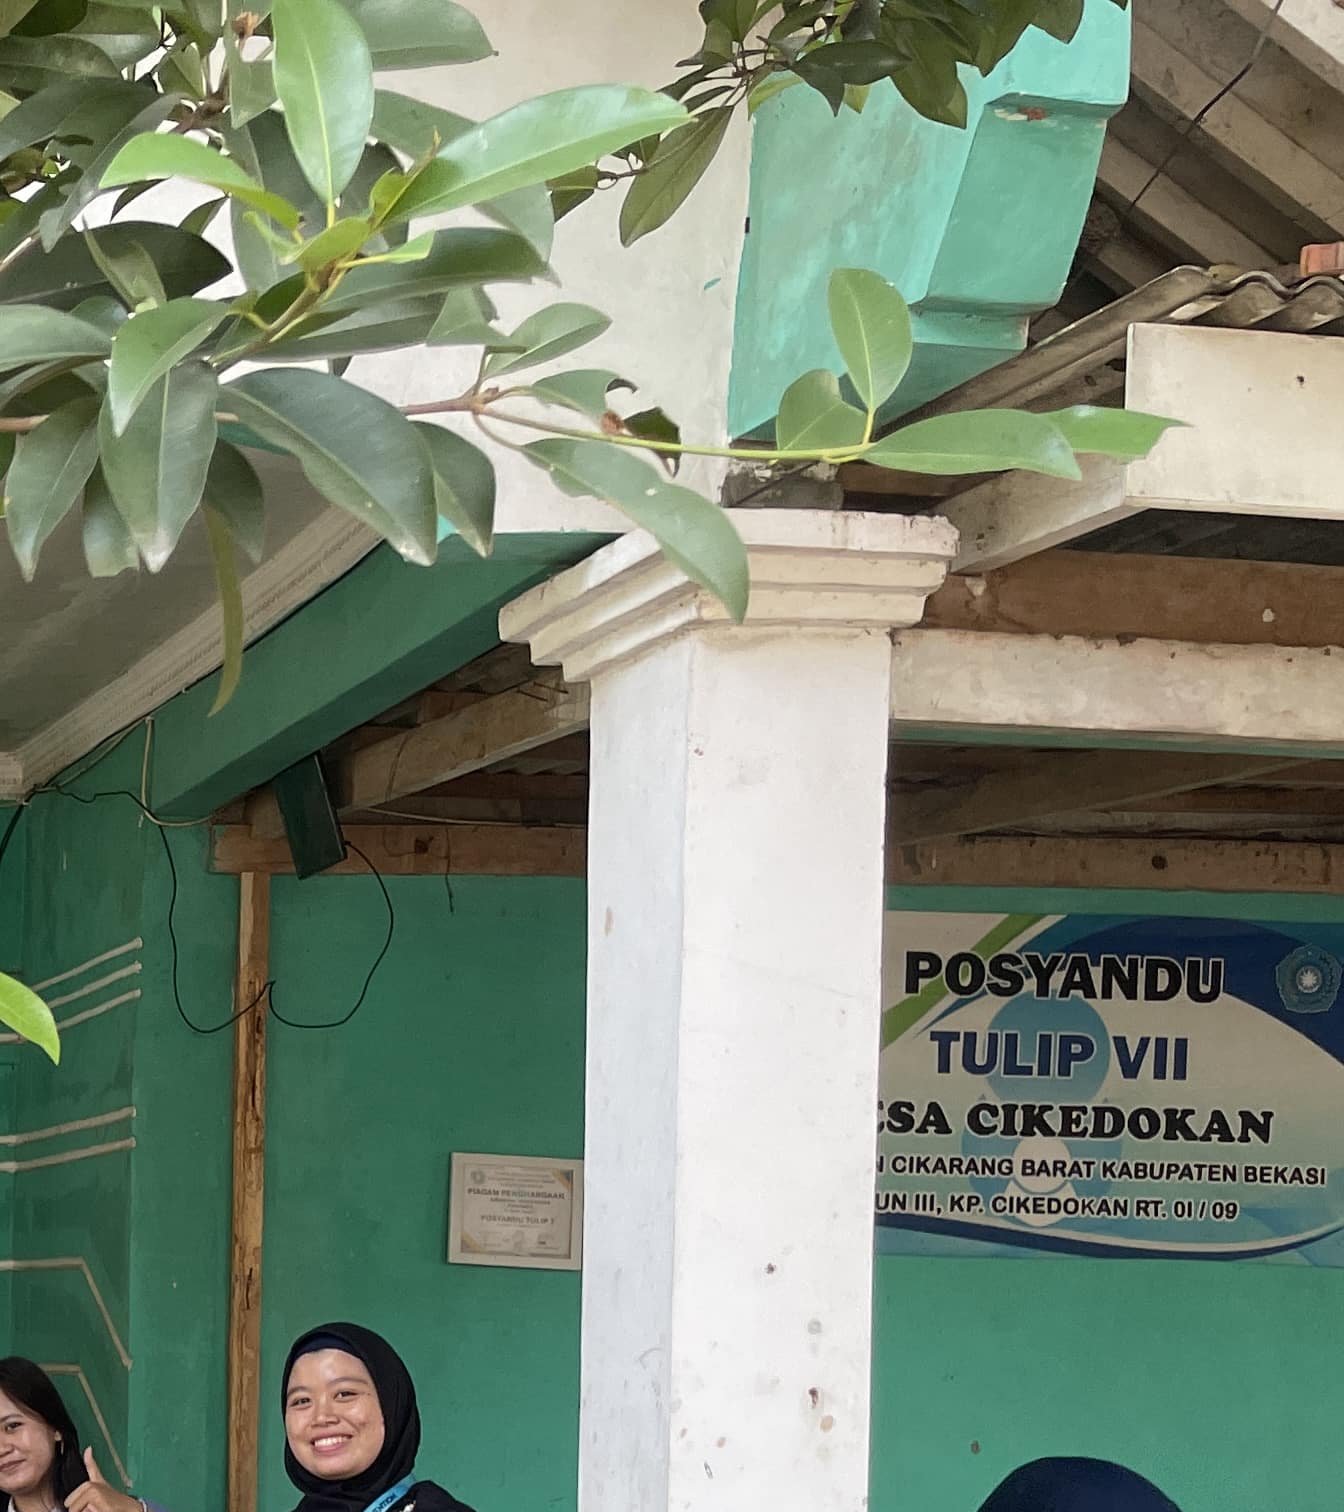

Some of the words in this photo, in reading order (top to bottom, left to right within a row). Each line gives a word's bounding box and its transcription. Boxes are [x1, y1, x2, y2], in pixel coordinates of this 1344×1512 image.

[904, 950, 1224, 1003] POSYANDU
[929, 1030, 1096, 1078] TULIP
[1112, 1035, 1189, 1081] VII
[966, 1102, 1275, 1144] CIKEDOKAN
[891, 1155, 1014, 1175] CIKARANG
[1020, 1159, 1096, 1178] BARAT
[1101, 1161, 1237, 1183] KABUPATEN
[1243, 1166, 1326, 1186] BEKASI
[949, 1195, 984, 1213] KP.
[991, 1195, 1128, 1217] CIKEDOKAN
[1135, 1200, 1167, 1218] RT.
[1211, 1201, 1238, 1220] 09
